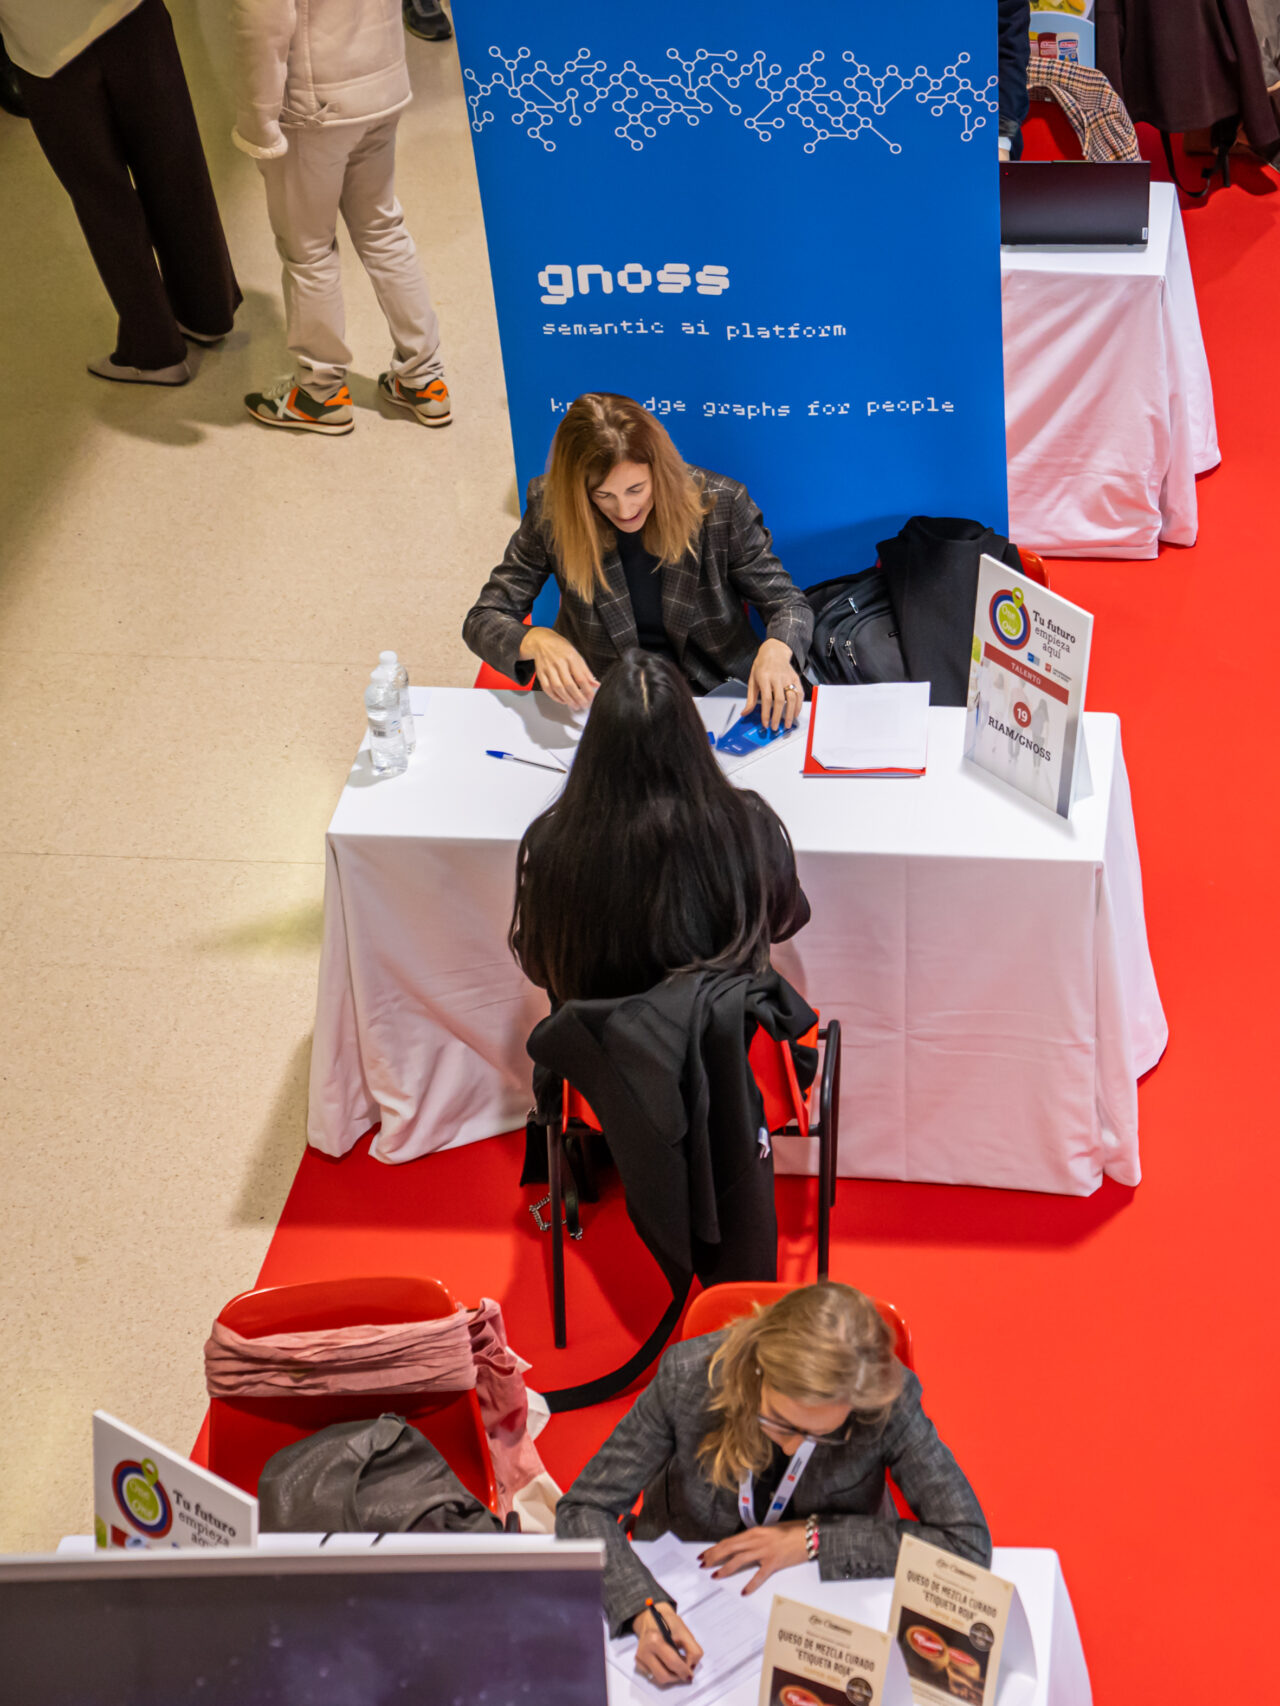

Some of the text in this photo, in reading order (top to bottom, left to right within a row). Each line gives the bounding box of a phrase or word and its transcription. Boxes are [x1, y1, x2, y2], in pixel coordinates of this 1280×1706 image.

[538, 263, 730, 305] gnoss
[542, 318, 846, 341] semantic ai platform
[702, 401, 791, 420] graphs
[807, 400, 850, 416] for
[866, 397, 955, 417] people
[1032, 610, 1076, 644] Tu futuro
[1035, 627, 1071, 654] empieza
[1042, 642, 1061, 660] aquí
[1011, 662, 1041, 684] TALENTO
[1016, 708, 1028, 723] 19
[988, 715, 1051, 762] RIAM/GNOSS
[172, 1489, 237, 1538] Tu futuro
[178, 1512, 230, 1548] empieza
[906, 1569, 930, 1588] QUESO
[930, 1580, 941, 1593] DE
[941, 1586, 968, 1604] MEZCLA
[968, 1598, 998, 1618] CURADO
[778, 1628, 803, 1647] QUESO
[803, 1638, 814, 1650] DE
[815, 1643, 843, 1660] MEZCLA
[844, 1653, 875, 1673] CURADO
